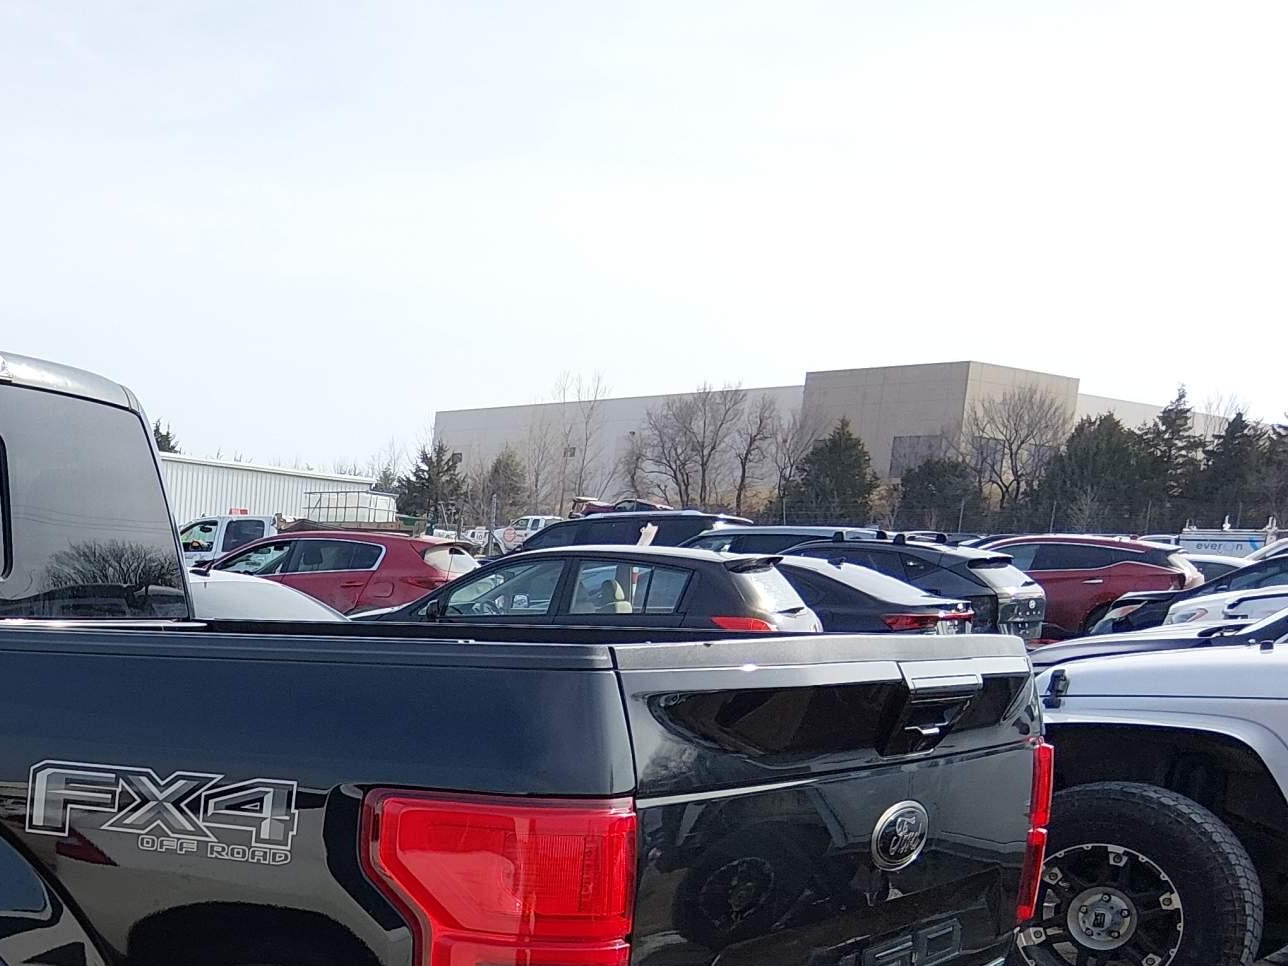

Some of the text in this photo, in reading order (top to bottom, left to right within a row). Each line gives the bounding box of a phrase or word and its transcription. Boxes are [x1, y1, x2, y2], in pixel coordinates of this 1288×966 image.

[25, 759, 299, 850] FX4
[138, 835, 292, 865] OFF ROAD
[890, 815, 922, 856] Ford
